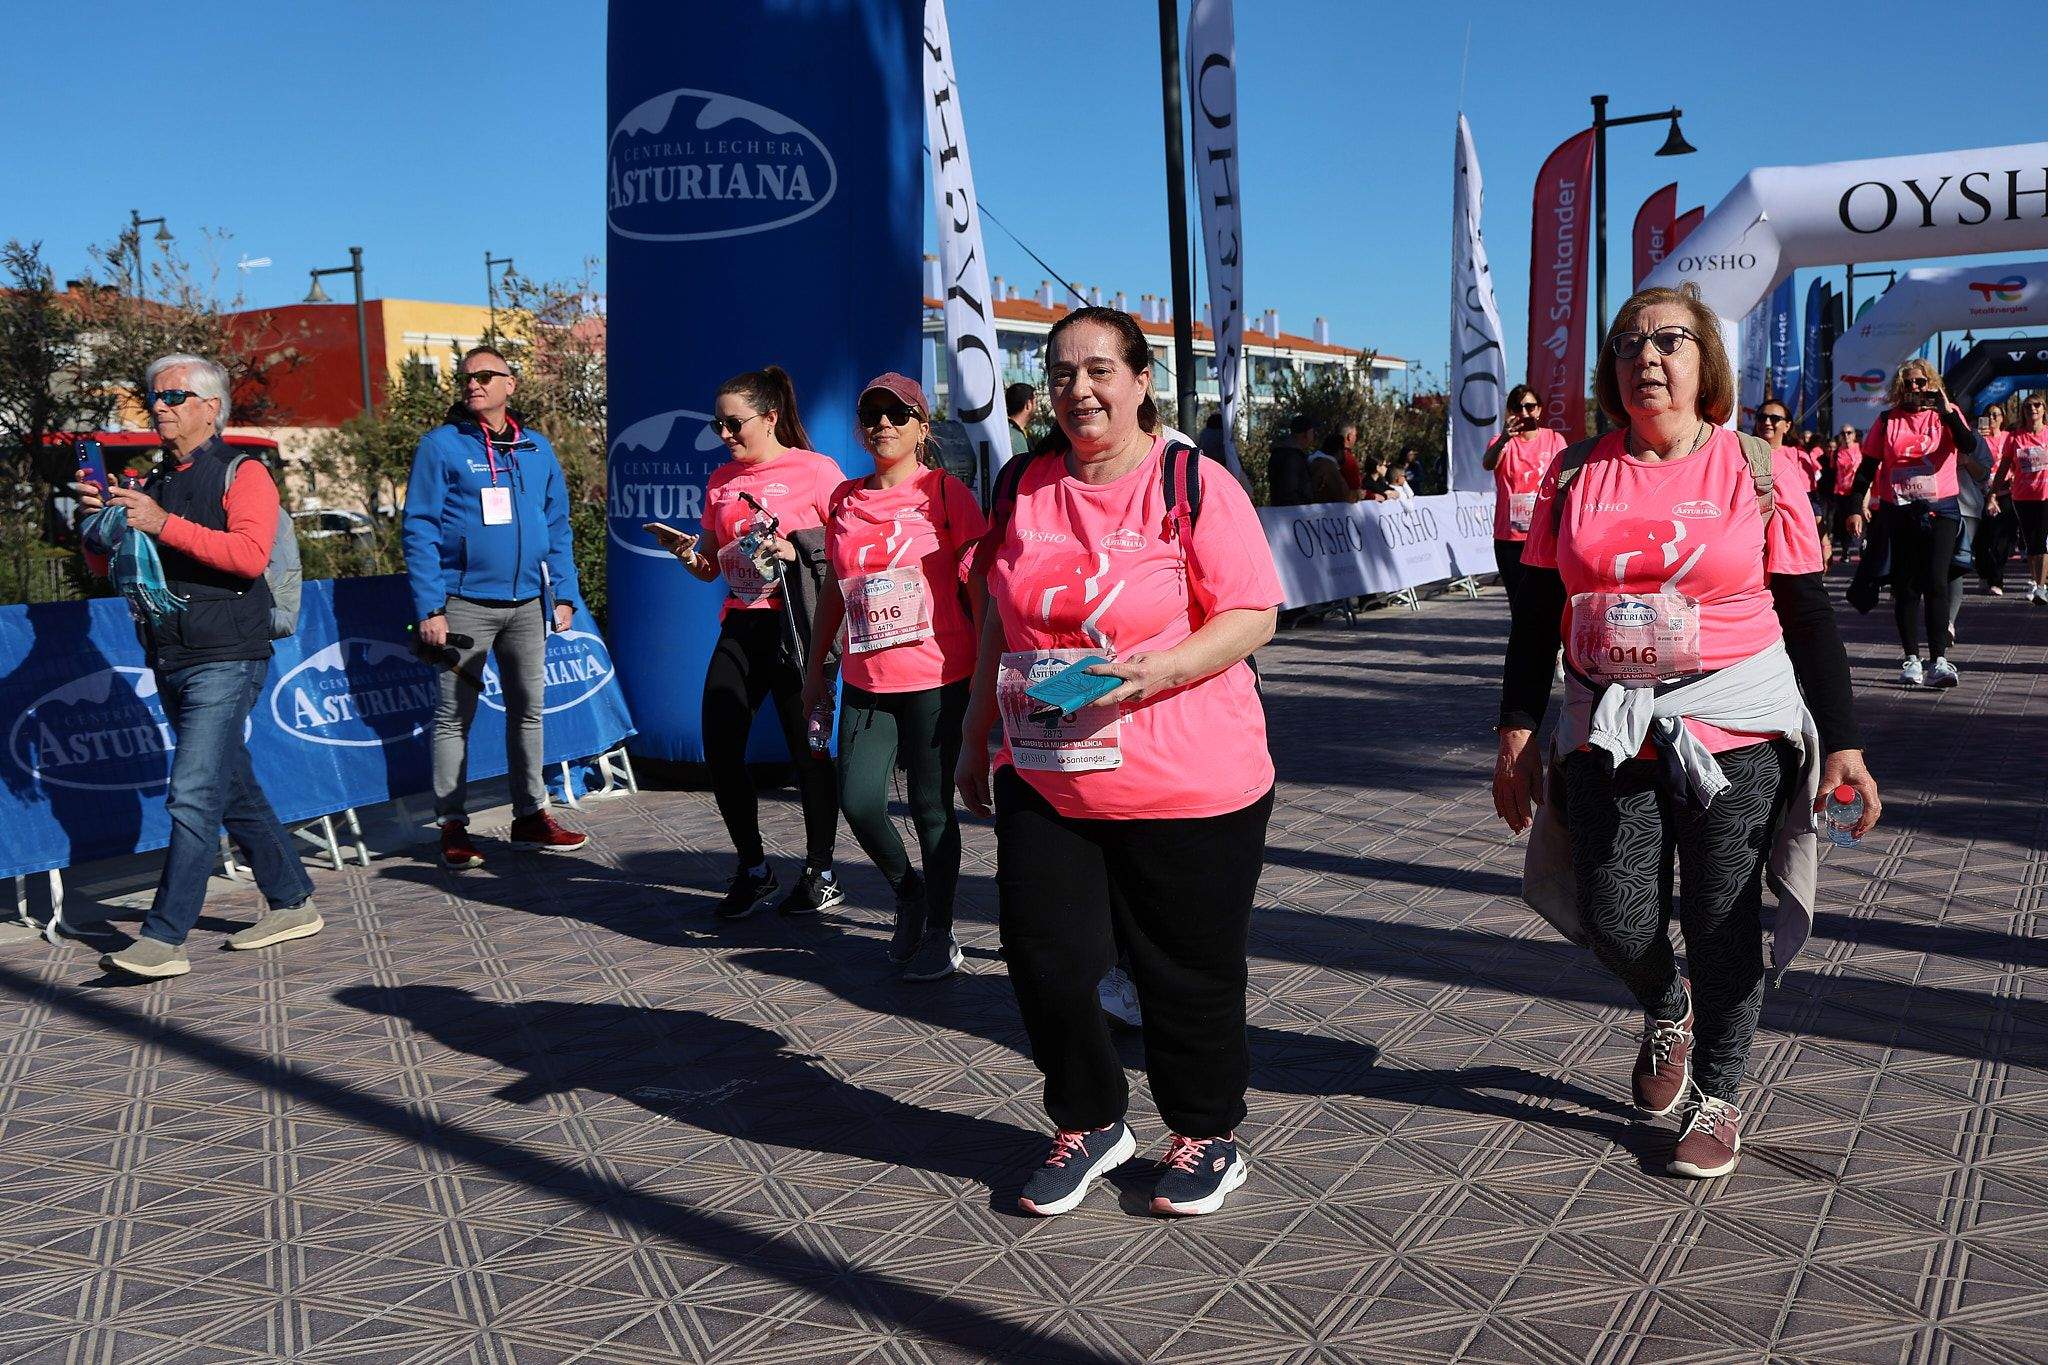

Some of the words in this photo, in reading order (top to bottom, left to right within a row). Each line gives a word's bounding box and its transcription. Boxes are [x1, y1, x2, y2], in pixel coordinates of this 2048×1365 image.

[624, 142, 695, 162] CENTRAL
[704, 140, 804, 157] LECHERA
[608, 157, 815, 211] ASTURIANA
[1839, 167, 2048, 234] OYSH
[1550, 178, 1576, 323] Santander
[1677, 253, 1756, 273] OYSHO
[1969, 304, 2028, 316] TotalEnergies
[624, 461, 693, 476] CENTRAL
[608, 466, 703, 519] ASTUR
[1017, 528, 1067, 543] OYSHO
[1293, 515, 1363, 558] OYSHO
[1379, 507, 1438, 550] OYSHO
[868, 605, 902, 623] 016
[1608, 610, 1654, 620] ASTURIANA
[877, 623, 894, 631] 4479
[545, 643, 589, 658] ECHERA
[1609, 646, 1658, 664] 016
[1043, 729, 1063, 739] 2873
[39, 722, 176, 768] ASTURI
[1066, 755, 1106, 764] Santander
